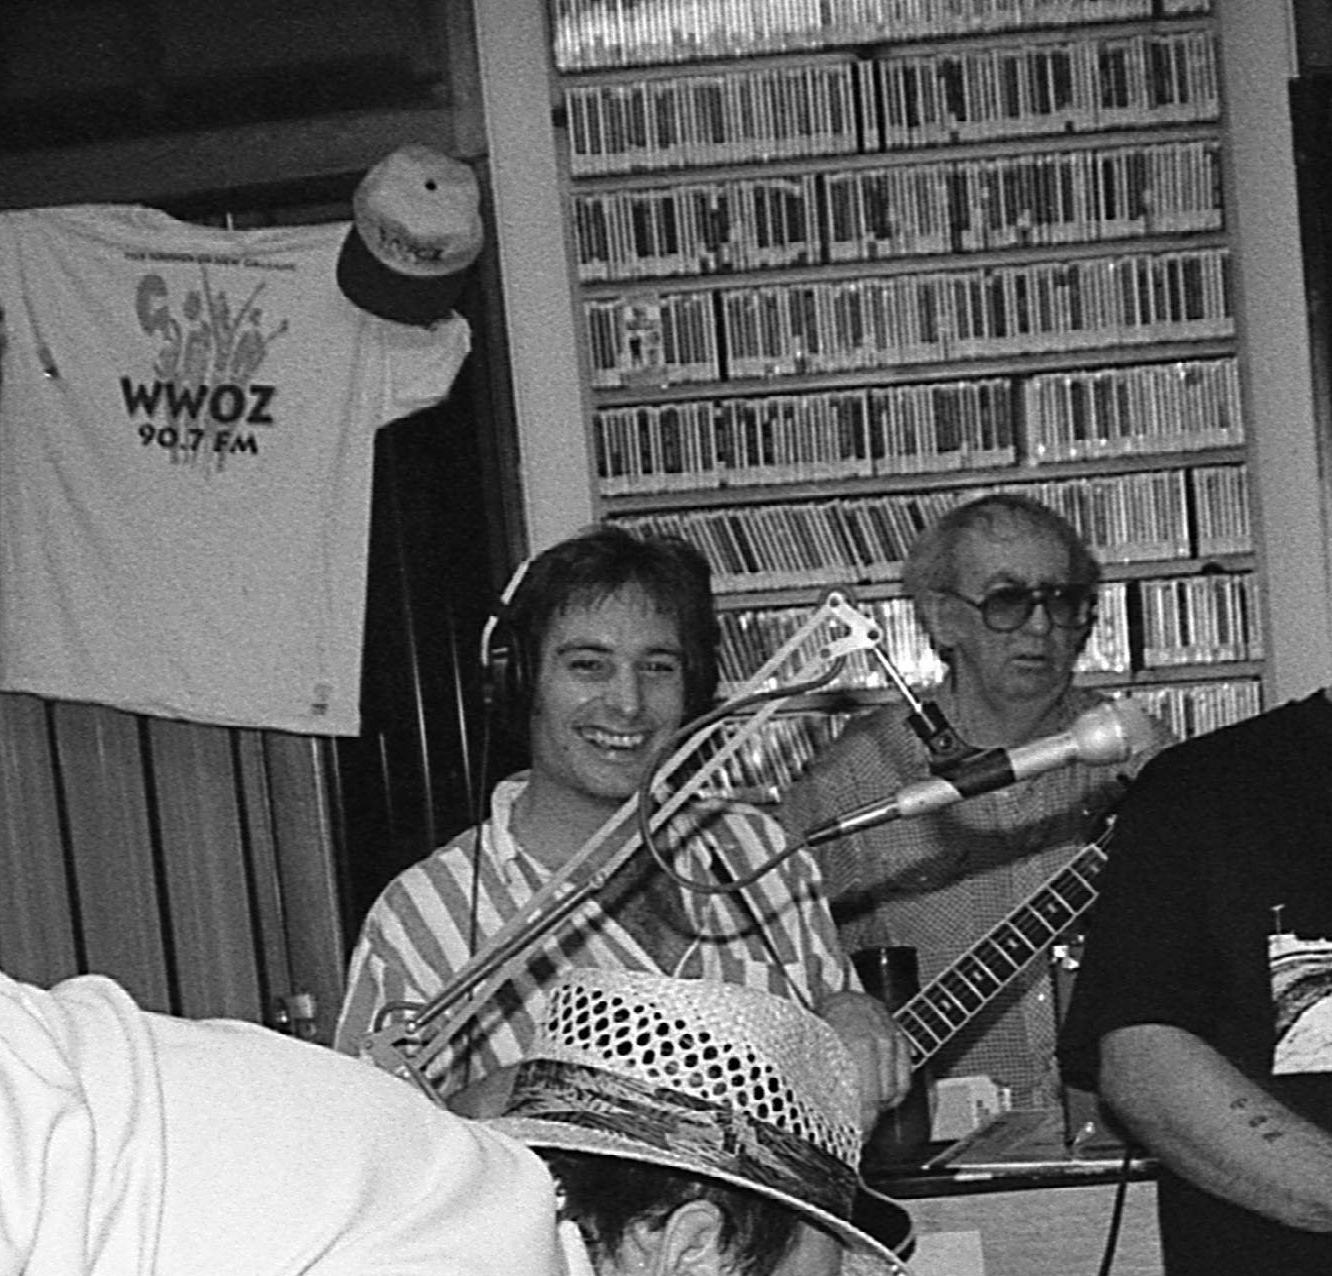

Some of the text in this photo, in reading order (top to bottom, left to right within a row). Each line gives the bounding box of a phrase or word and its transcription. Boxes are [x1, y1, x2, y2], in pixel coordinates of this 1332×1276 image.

[120, 375, 276, 423] WWOZ
[138, 423, 259, 454] 90.7 FM
